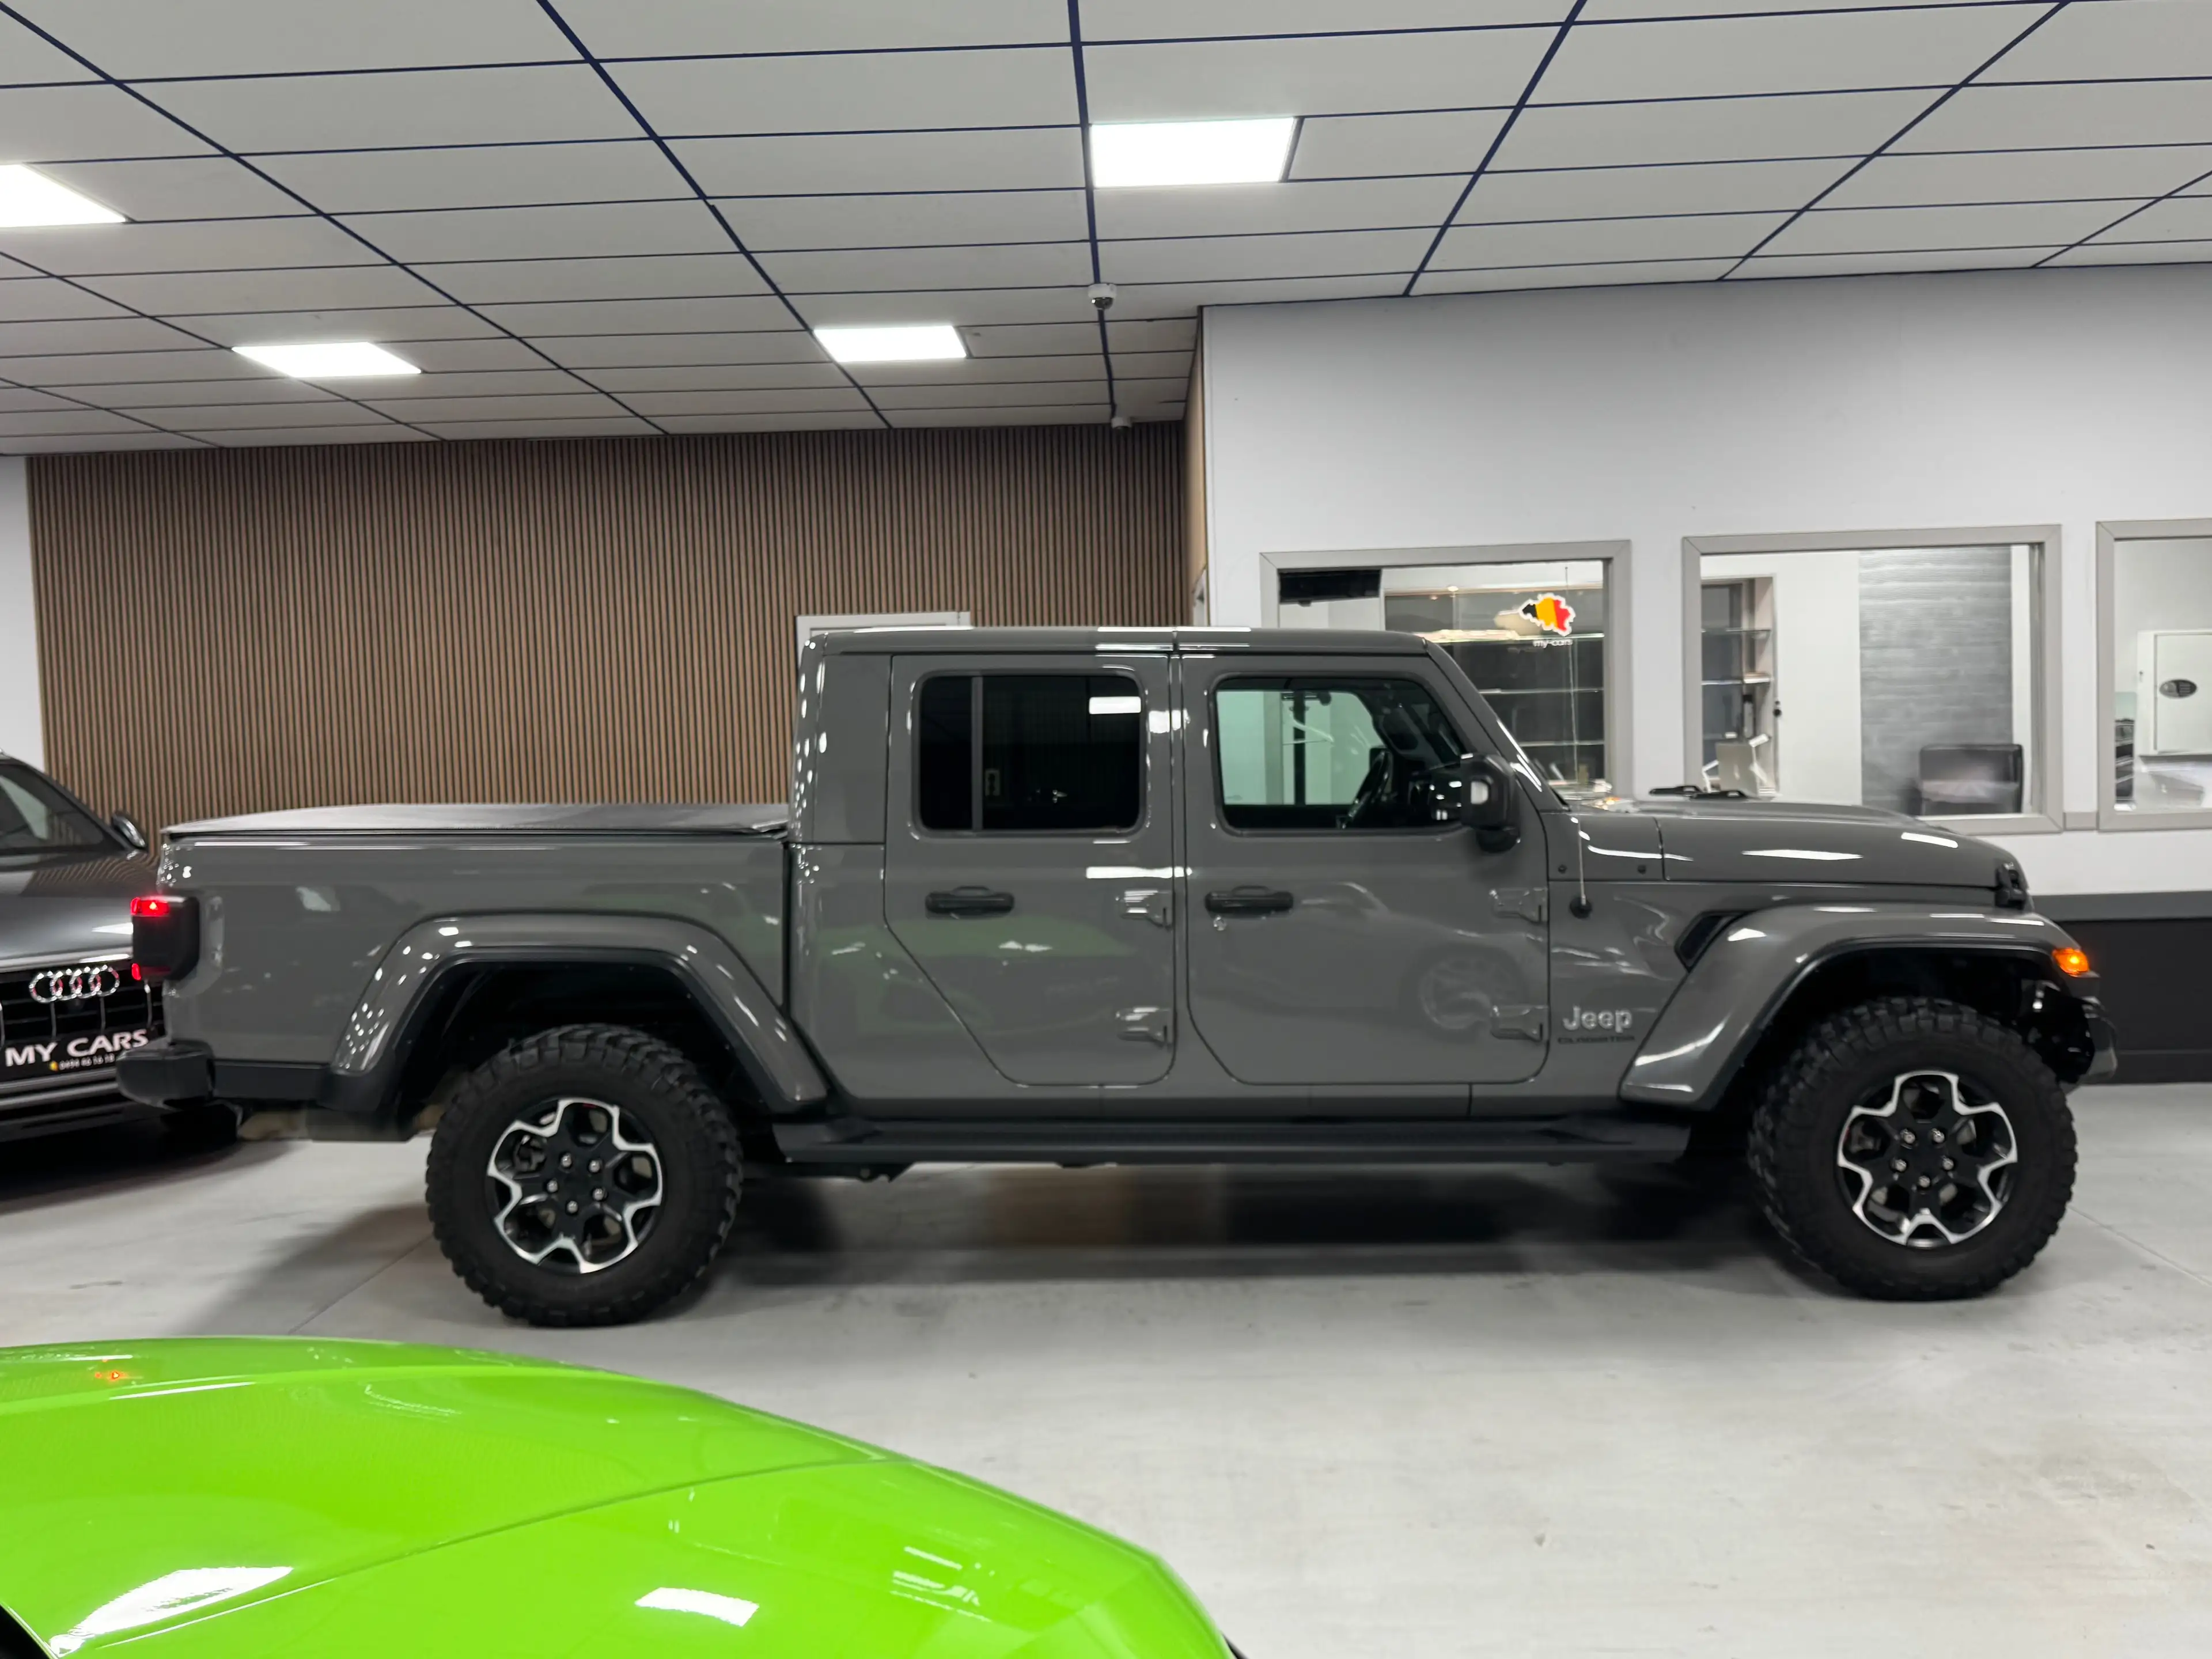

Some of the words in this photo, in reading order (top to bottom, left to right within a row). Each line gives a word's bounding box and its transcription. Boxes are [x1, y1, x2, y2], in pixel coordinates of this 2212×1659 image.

[1562, 1005, 1633, 1033] Jeep
[5, 1043, 57, 1066] MY
[67, 1029, 149, 1058] CARS
